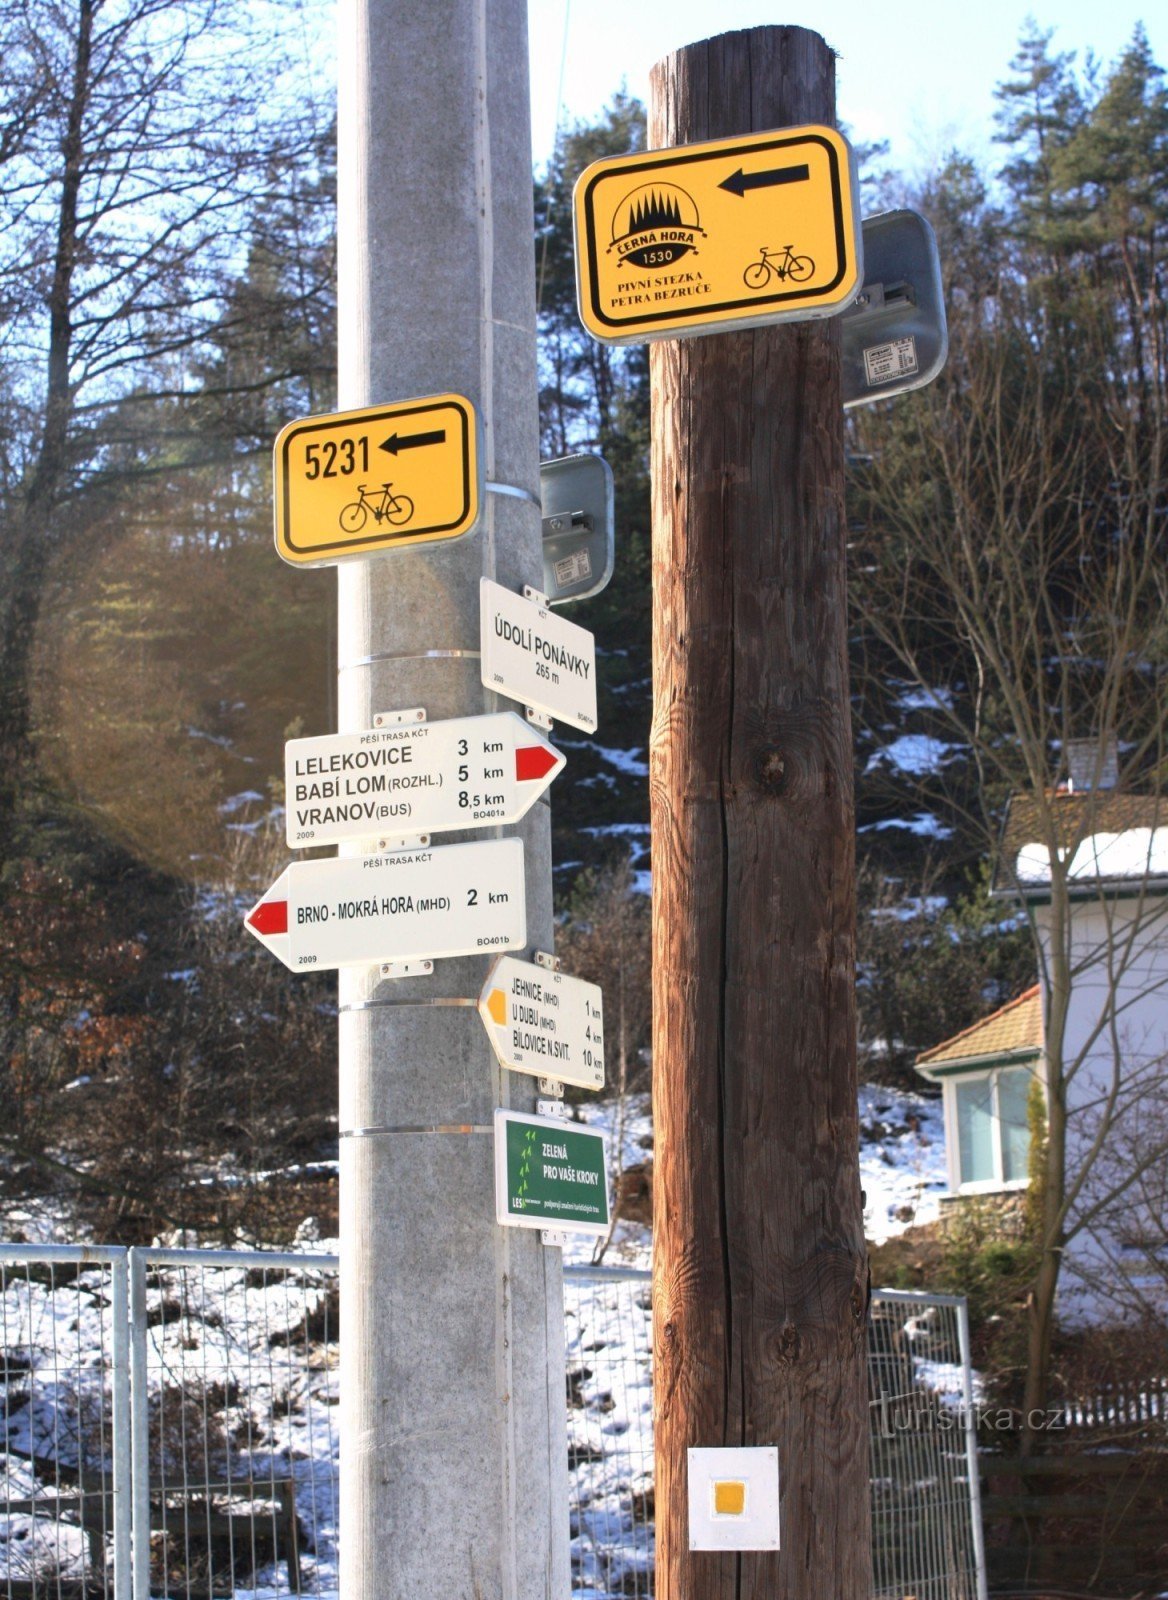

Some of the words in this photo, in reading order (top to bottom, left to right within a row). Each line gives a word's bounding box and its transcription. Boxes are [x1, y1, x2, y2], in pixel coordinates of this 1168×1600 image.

[617, 232, 657, 255] ČERNÁ
[660, 231, 694, 243] HORA
[643, 250, 673, 264] 1530
[618, 277, 651, 292] PIVNÍ
[654, 271, 702, 287] STEZKA
[611, 294, 651, 307] PETRA
[654, 283, 712, 301] BEZRUČE
[305, 436, 369, 480] 5231
[495, 613, 532, 652] ÚDOLÍ
[535, 636, 590, 680] PONÁVKY
[536, 662, 550, 680] 265
[551, 674, 560, 685] m
[360, 734, 379, 744] PĚŠÍ
[381, 731, 410, 742] TRASA
[411, 728, 429, 738] KČT
[295, 746, 412, 776] LELEKOVICE
[458, 739, 469, 756] 3
[483, 742, 503, 753] km
[295, 776, 339, 801] BABÍ
[458, 765, 469, 781] 5
[484, 768, 503, 779] km
[458, 791, 480, 809] 8,5
[484, 794, 504, 805] km
[296, 830, 315, 840] 2009
[473, 810, 505, 819] BO401a
[363, 859, 382, 868] PĚŠÍ
[385, 856, 413, 866] TRASA
[415, 853, 432, 862] KČT
[297, 904, 329, 924] BRNO
[338, 895, 379, 920] MOKRÁ
[382, 895, 414, 916] HORA
[416, 897, 450, 914] (MHD)
[467, 889, 478, 906] 2
[488, 892, 508, 904] km
[298, 955, 318, 964] 2009
[477, 936, 510, 946] BO401b
[511, 978, 542, 1002] JEHNICE
[543, 992, 560, 1010] (MHD)
[585, 1000, 590, 1017] 1
[592, 1007, 601, 1019] km
[512, 1004, 518, 1021] U
[519, 1005, 539, 1027] DUBU
[540, 1016, 557, 1034] (MHD)
[585, 1025, 591, 1042] 4
[593, 1032, 602, 1045] km
[513, 1028, 546, 1055] BÍLOVICE
[582, 1049, 592, 1067] 10
[594, 1056, 603, 1069] km
[542, 1143, 568, 1160] ZELENÁ
[543, 1165, 557, 1180] PRO
[558, 1165, 576, 1183] VAŠE
[576, 1171, 599, 1186] KROKY
